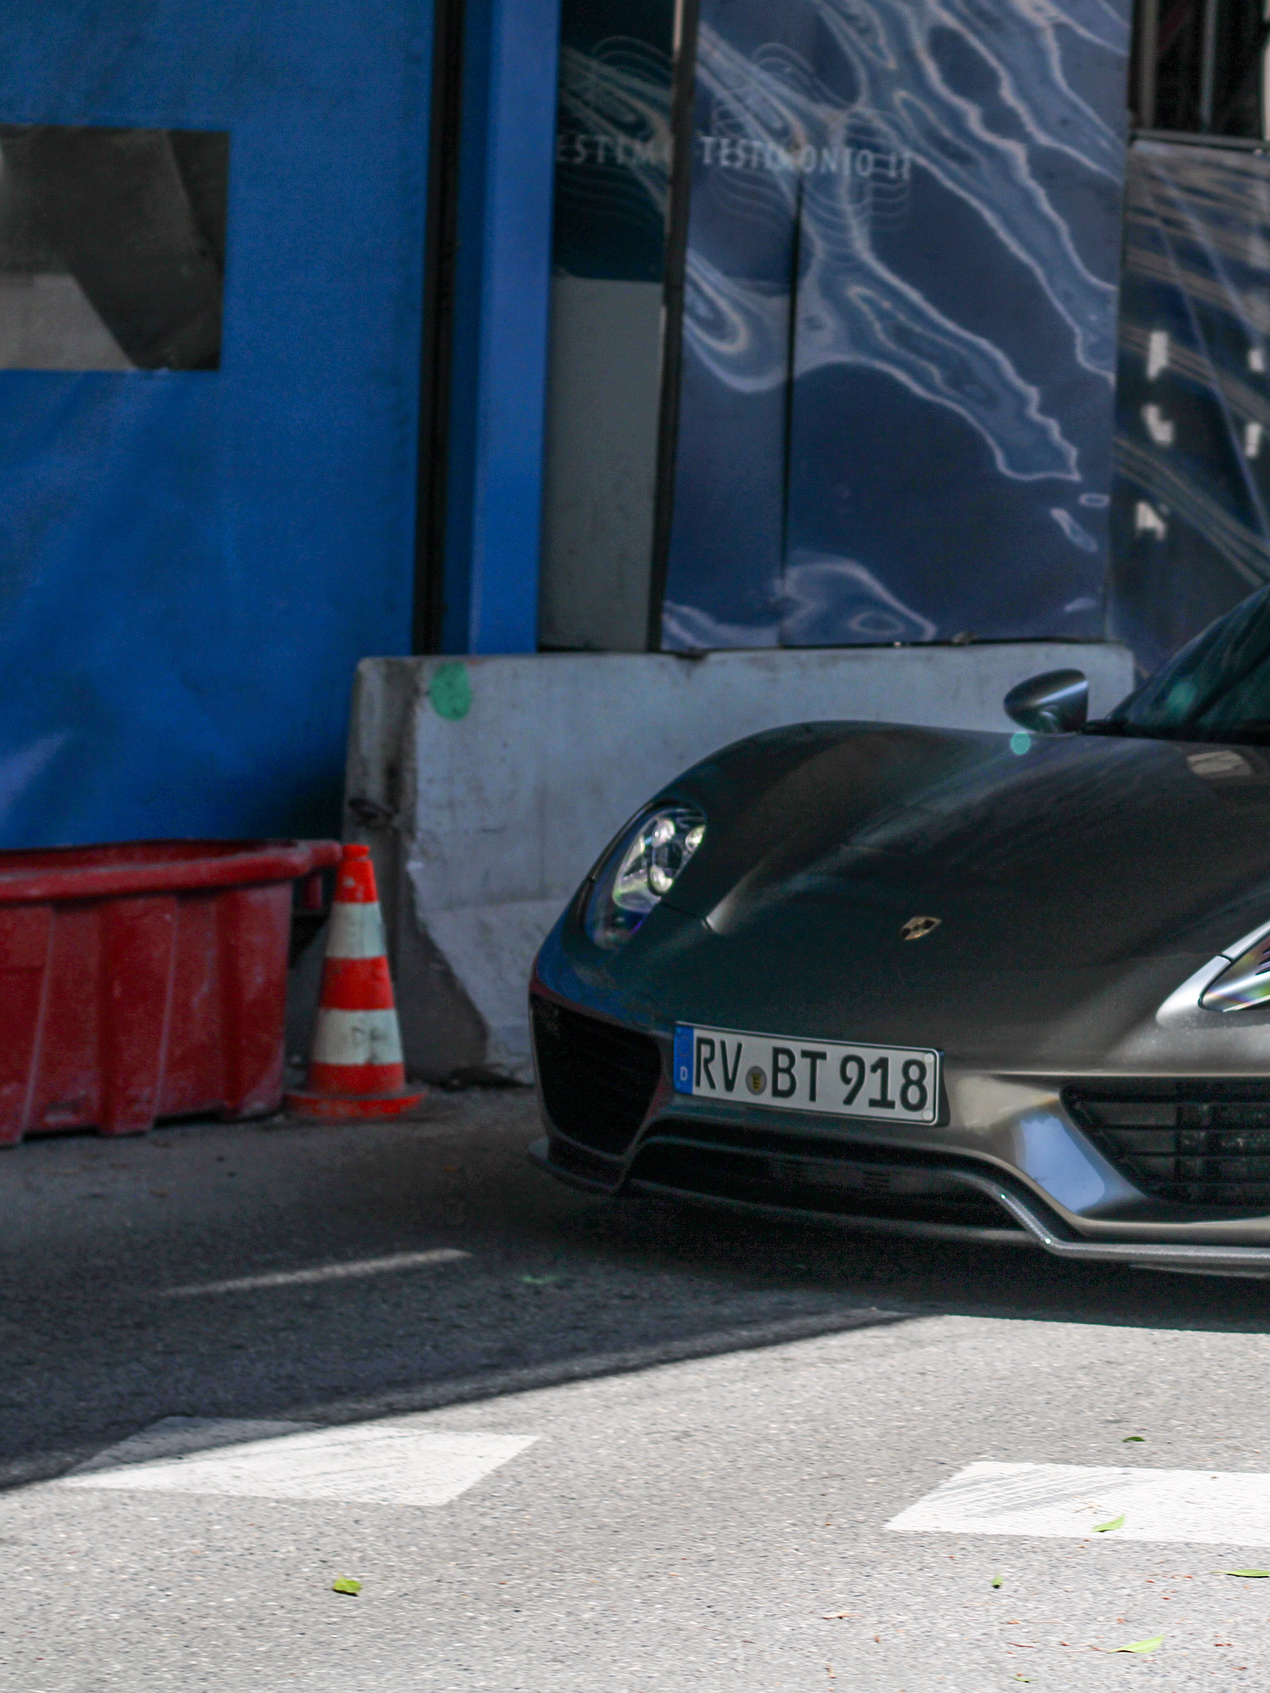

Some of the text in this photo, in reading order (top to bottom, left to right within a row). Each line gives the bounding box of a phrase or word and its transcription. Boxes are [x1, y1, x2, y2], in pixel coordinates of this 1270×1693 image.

[679, 1066, 688, 1081] D
[695, 1037, 927, 1112] RV BT 918
